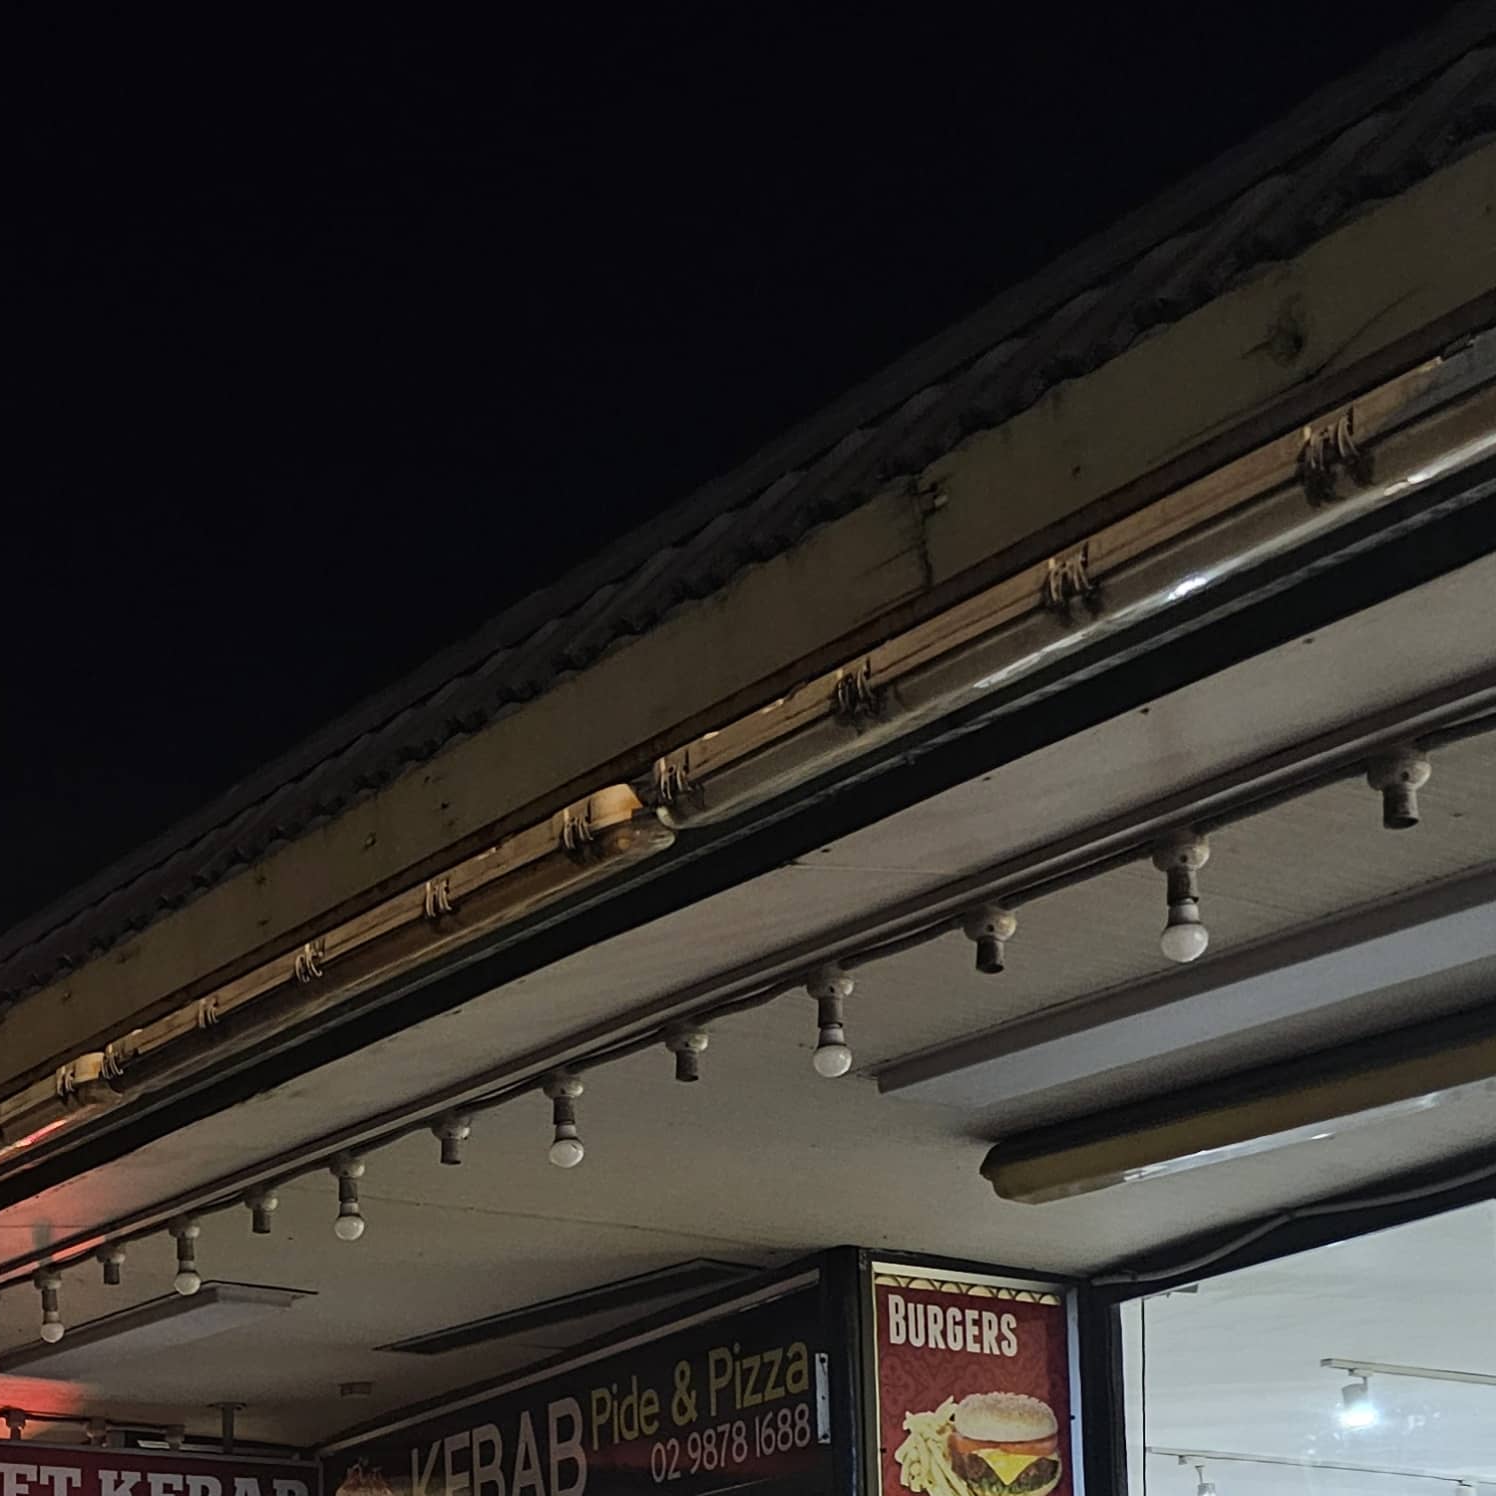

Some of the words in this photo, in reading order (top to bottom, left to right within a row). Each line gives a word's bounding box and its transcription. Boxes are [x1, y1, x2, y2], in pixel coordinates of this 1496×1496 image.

[887, 1293, 1018, 1358] BURGERS
[591, 1375, 660, 1451] Pide
[671, 1359, 698, 1426] &
[709, 1340, 809, 1418] Pizza
[650, 1442, 682, 1485] 02
[687, 1423, 748, 1478] 9878
[754, 1402, 812, 1459] 1688
